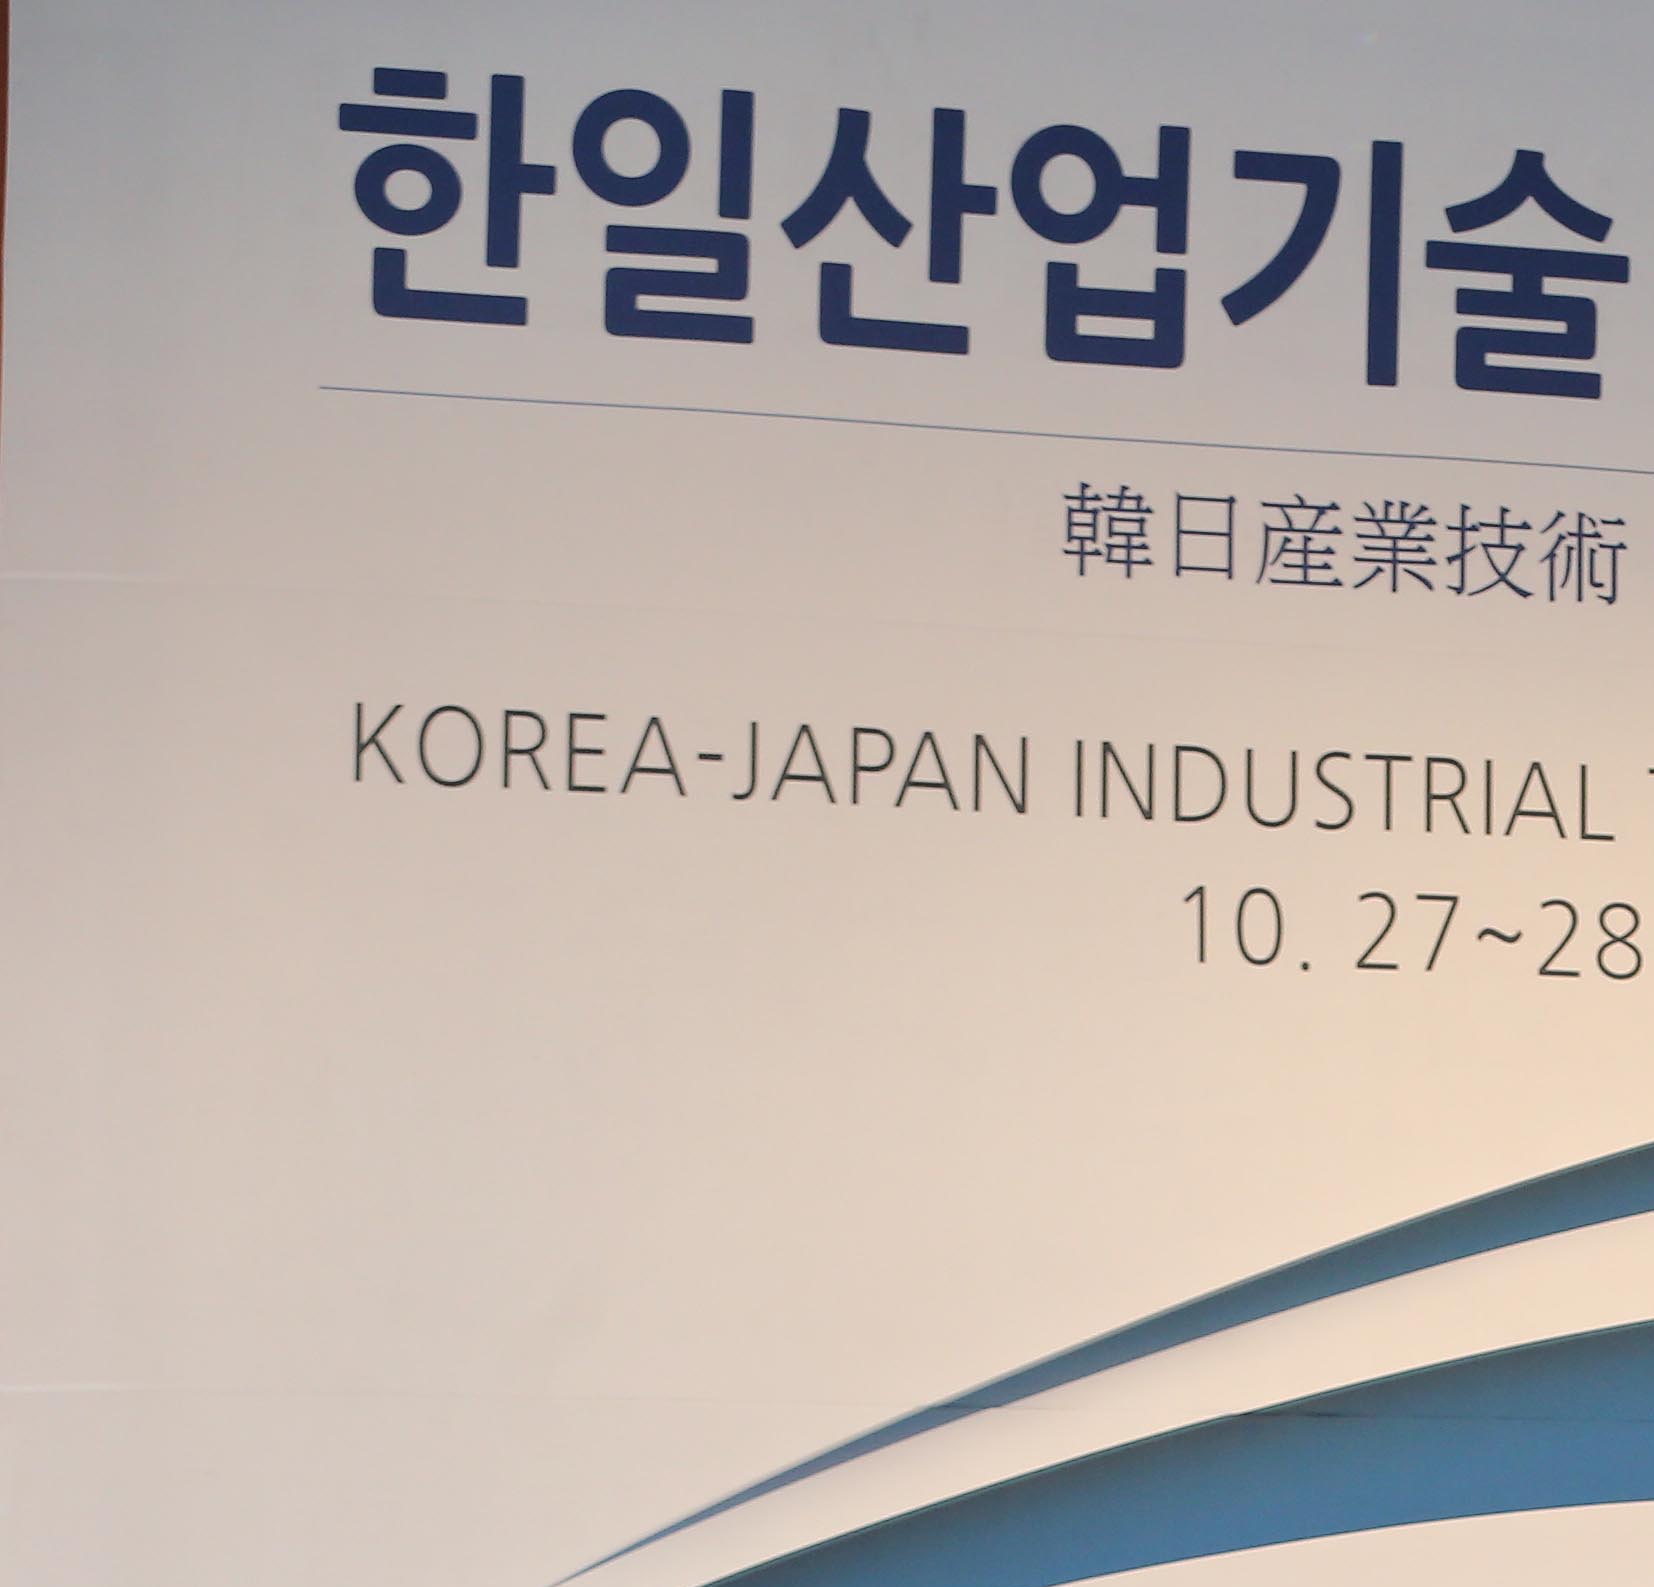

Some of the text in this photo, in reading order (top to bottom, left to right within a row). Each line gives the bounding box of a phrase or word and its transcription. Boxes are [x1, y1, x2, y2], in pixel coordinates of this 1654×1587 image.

[338, 66, 1630, 400] 한일산업기술
[1061, 480, 1628, 606] 韓日産業技術
[352, 701, 1028, 815] KOREA-JAPAN
[1074, 738, 1616, 841] INDUSTRIAL
[1183, 884, 1313, 972] 10.
[1355, 891, 1644, 980] 27~28
